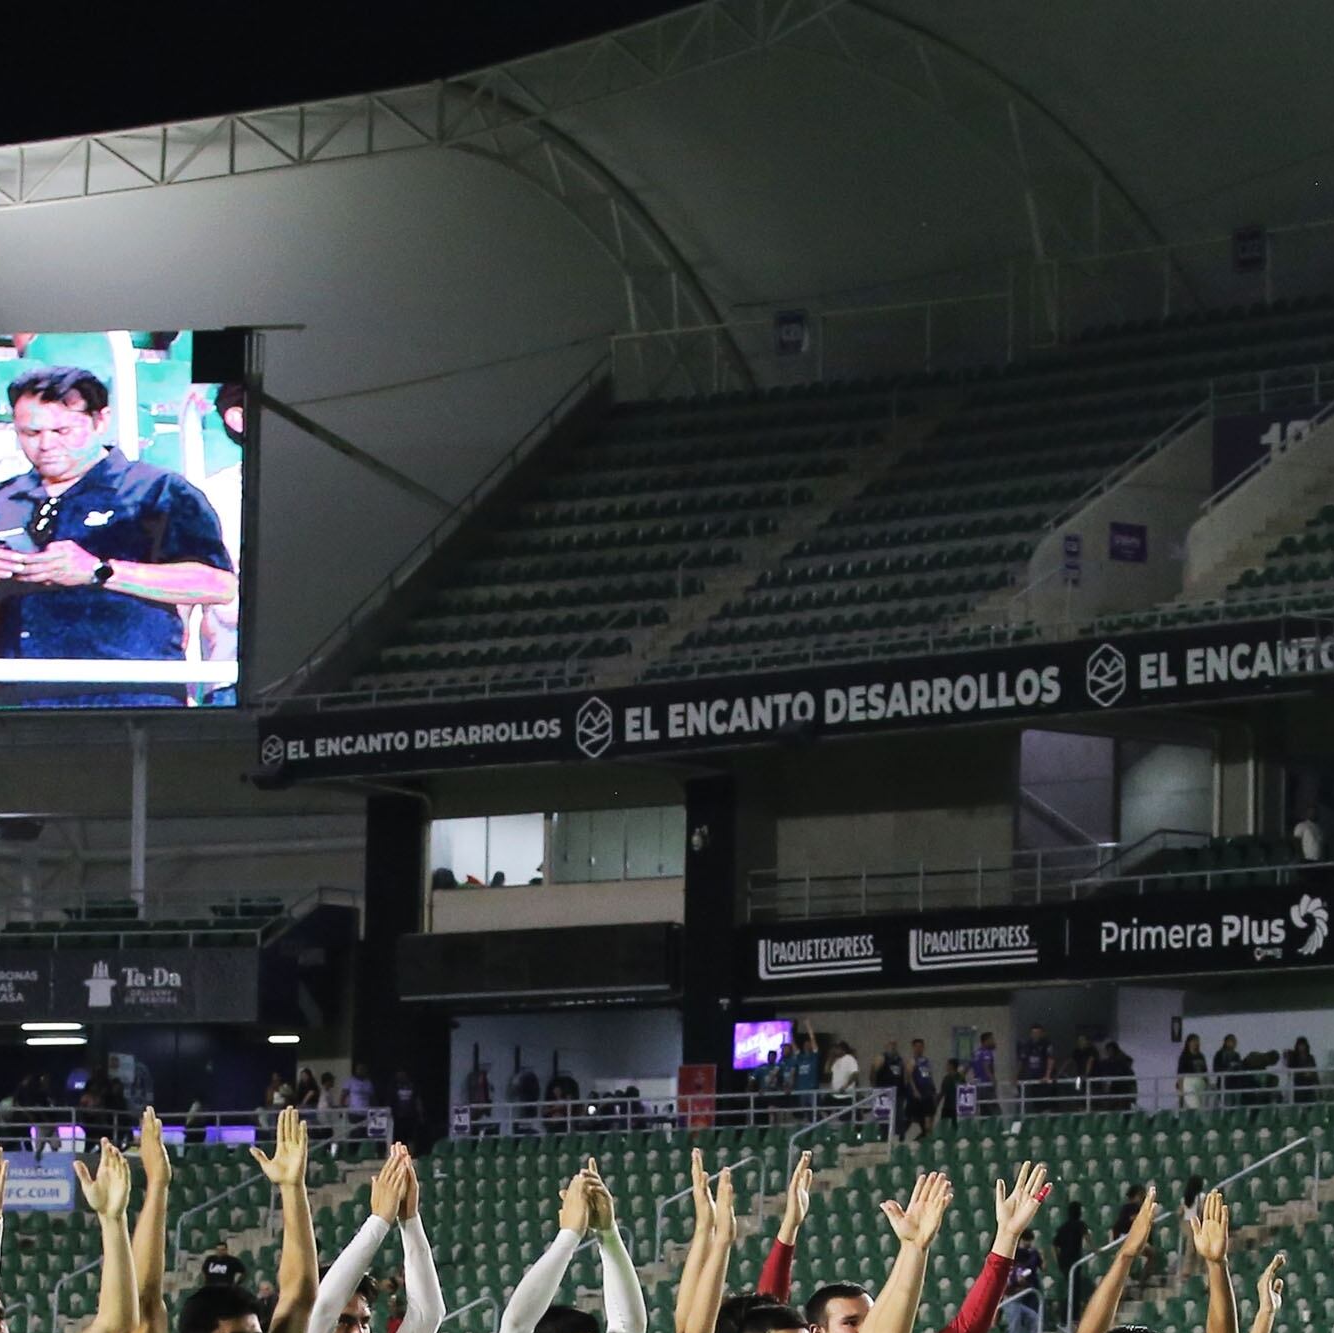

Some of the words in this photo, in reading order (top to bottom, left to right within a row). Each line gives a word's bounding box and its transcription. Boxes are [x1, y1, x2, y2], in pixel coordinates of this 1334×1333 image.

[1139, 650, 1177, 690] EL
[624, 705, 661, 743] EL
[667, 692, 815, 738] ENCANTO
[824, 665, 1062, 724] DESARROLLOS
[286, 740, 310, 761] EL
[314, 731, 409, 759] ENCANTO
[413, 718, 562, 751] DESARROLLOS
[772, 934, 875, 964] PAQUETEXPRESS
[923, 924, 1031, 953] PAQUETEXPRESS
[1100, 916, 1213, 953] Primera
[1220, 914, 1287, 947] Plus
